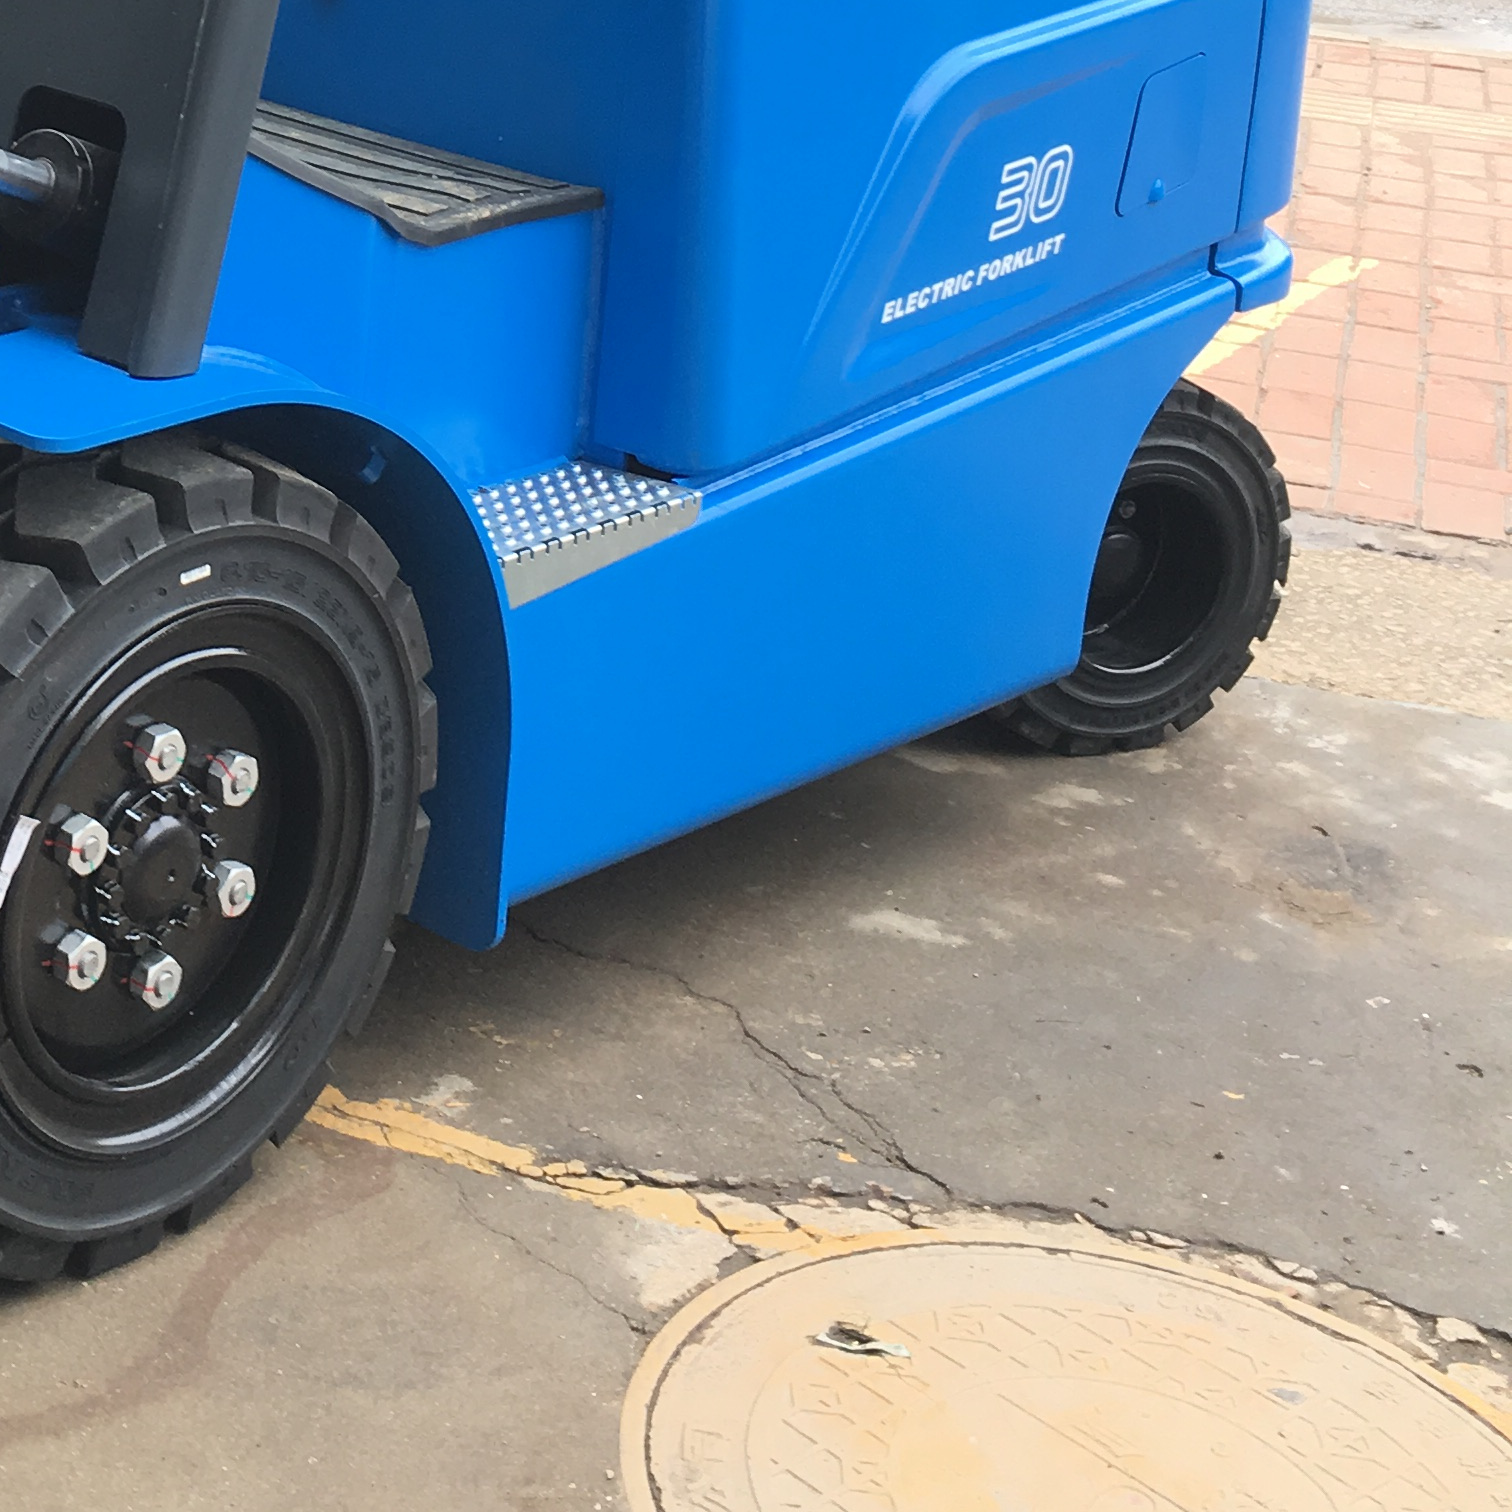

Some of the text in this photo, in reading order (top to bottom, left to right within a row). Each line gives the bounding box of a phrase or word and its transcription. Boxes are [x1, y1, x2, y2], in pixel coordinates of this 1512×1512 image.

[988, 144, 1074, 242] 30
[880, 233, 1066, 324] ELECTRIC FORKLIFT
